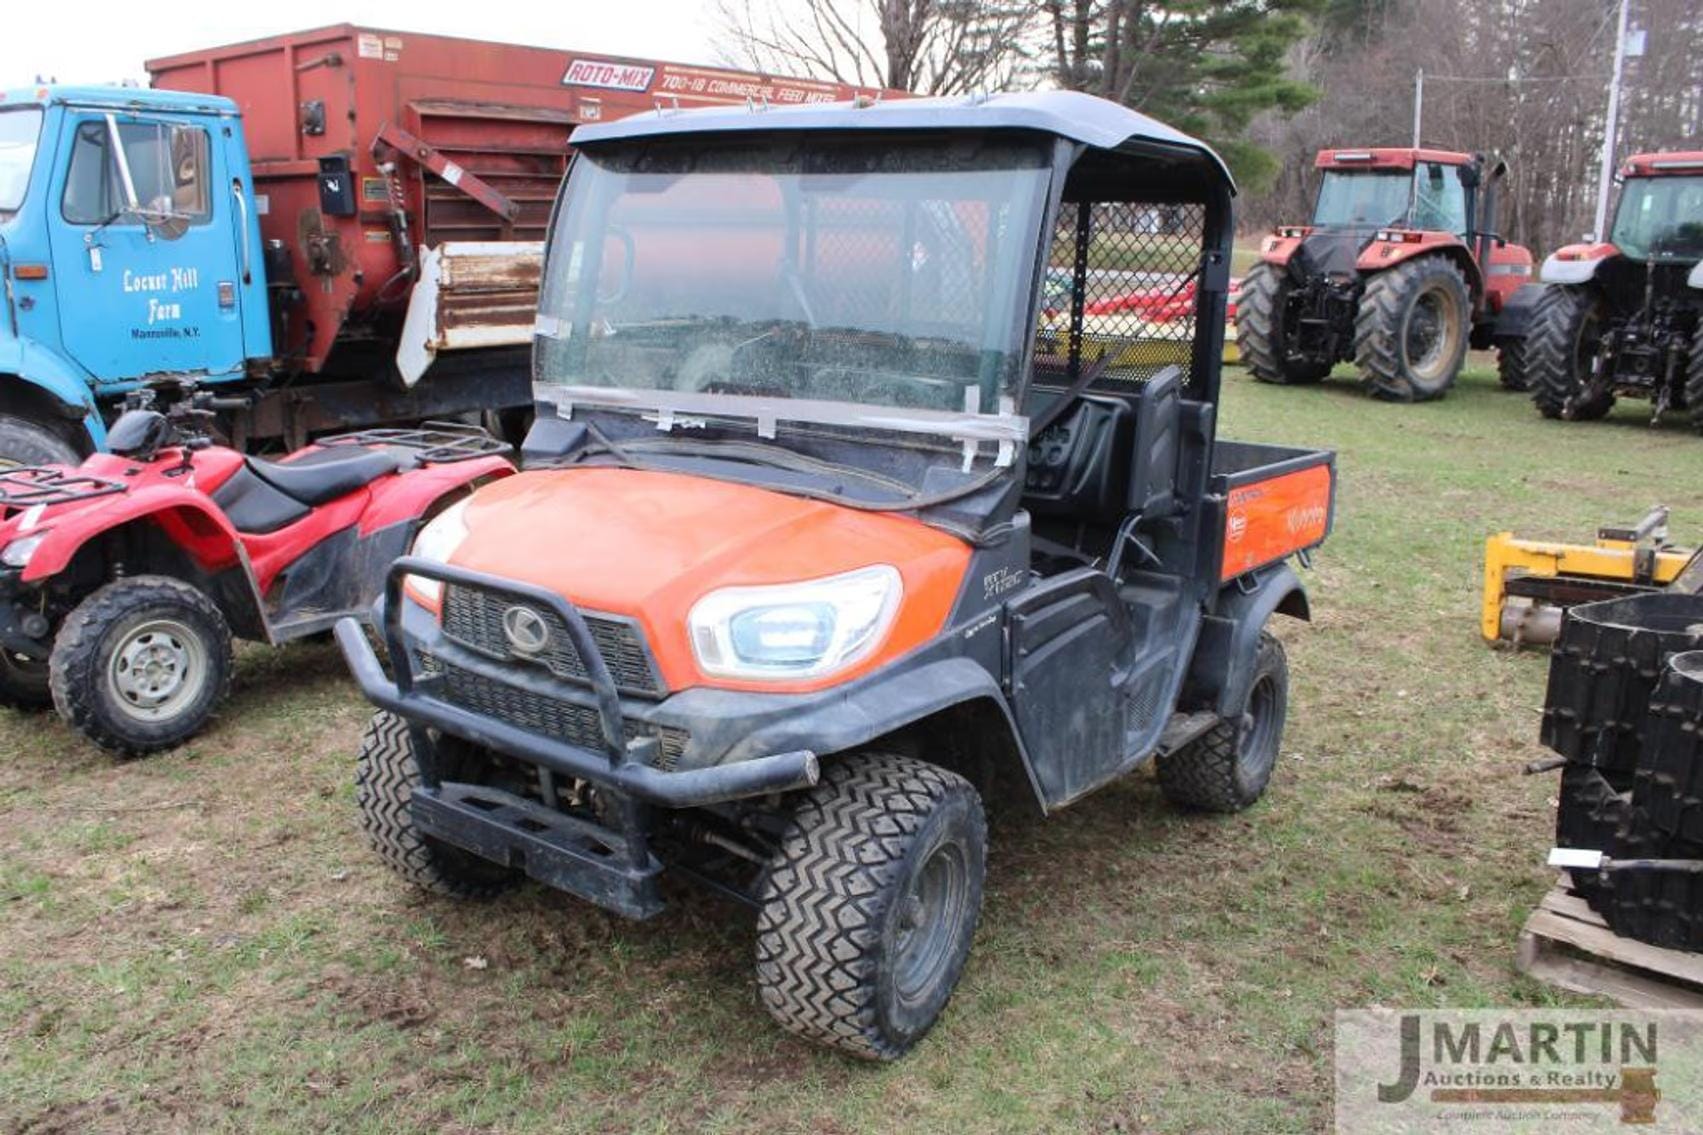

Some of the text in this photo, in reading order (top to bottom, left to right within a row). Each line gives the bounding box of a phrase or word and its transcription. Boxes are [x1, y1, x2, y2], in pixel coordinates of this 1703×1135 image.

[569, 63, 650, 88] ROTO-MIX
[123, 268, 198, 292] Locust Hill
[148, 298, 181, 325] Farm
[183, 327, 200, 337] N.Y.
